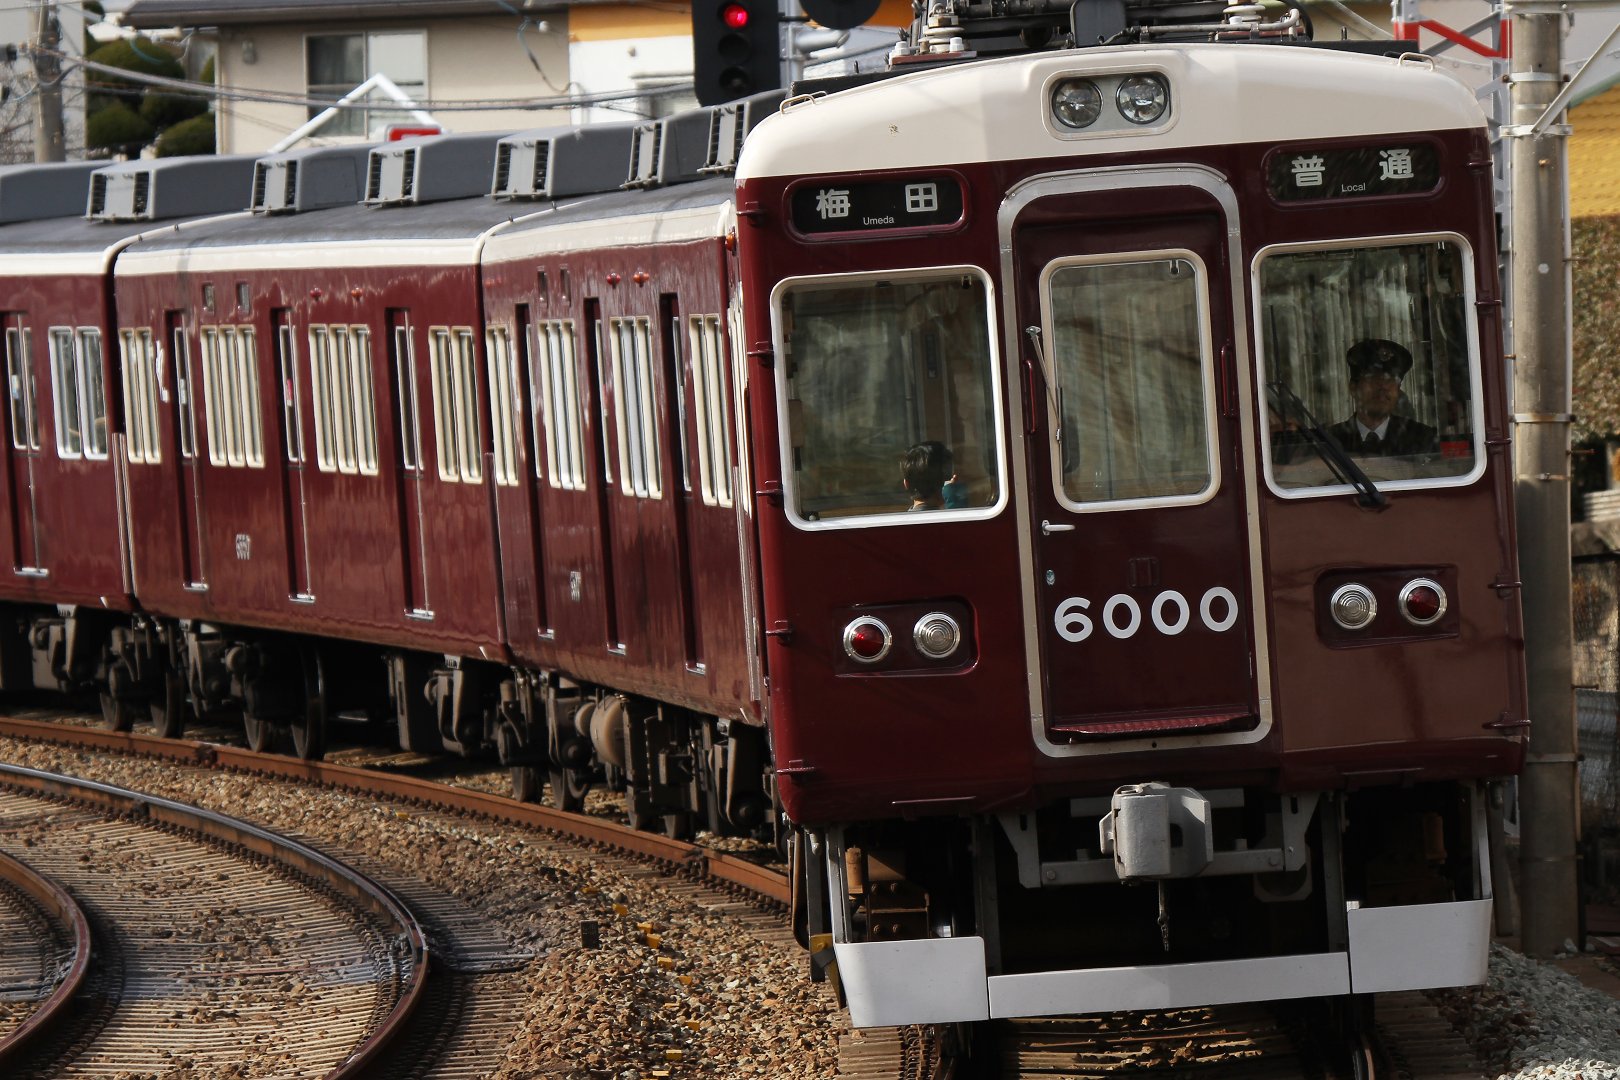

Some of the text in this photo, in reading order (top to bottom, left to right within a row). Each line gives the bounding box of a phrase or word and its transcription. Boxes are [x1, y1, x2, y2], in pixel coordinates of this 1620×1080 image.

[1291, 149, 1414, 187] 普通
[816, 183, 938, 220] 梅田
[1341, 182, 1366, 192] Local
[863, 215, 895, 225] Umeda
[1054, 586, 1239, 642] 6000
